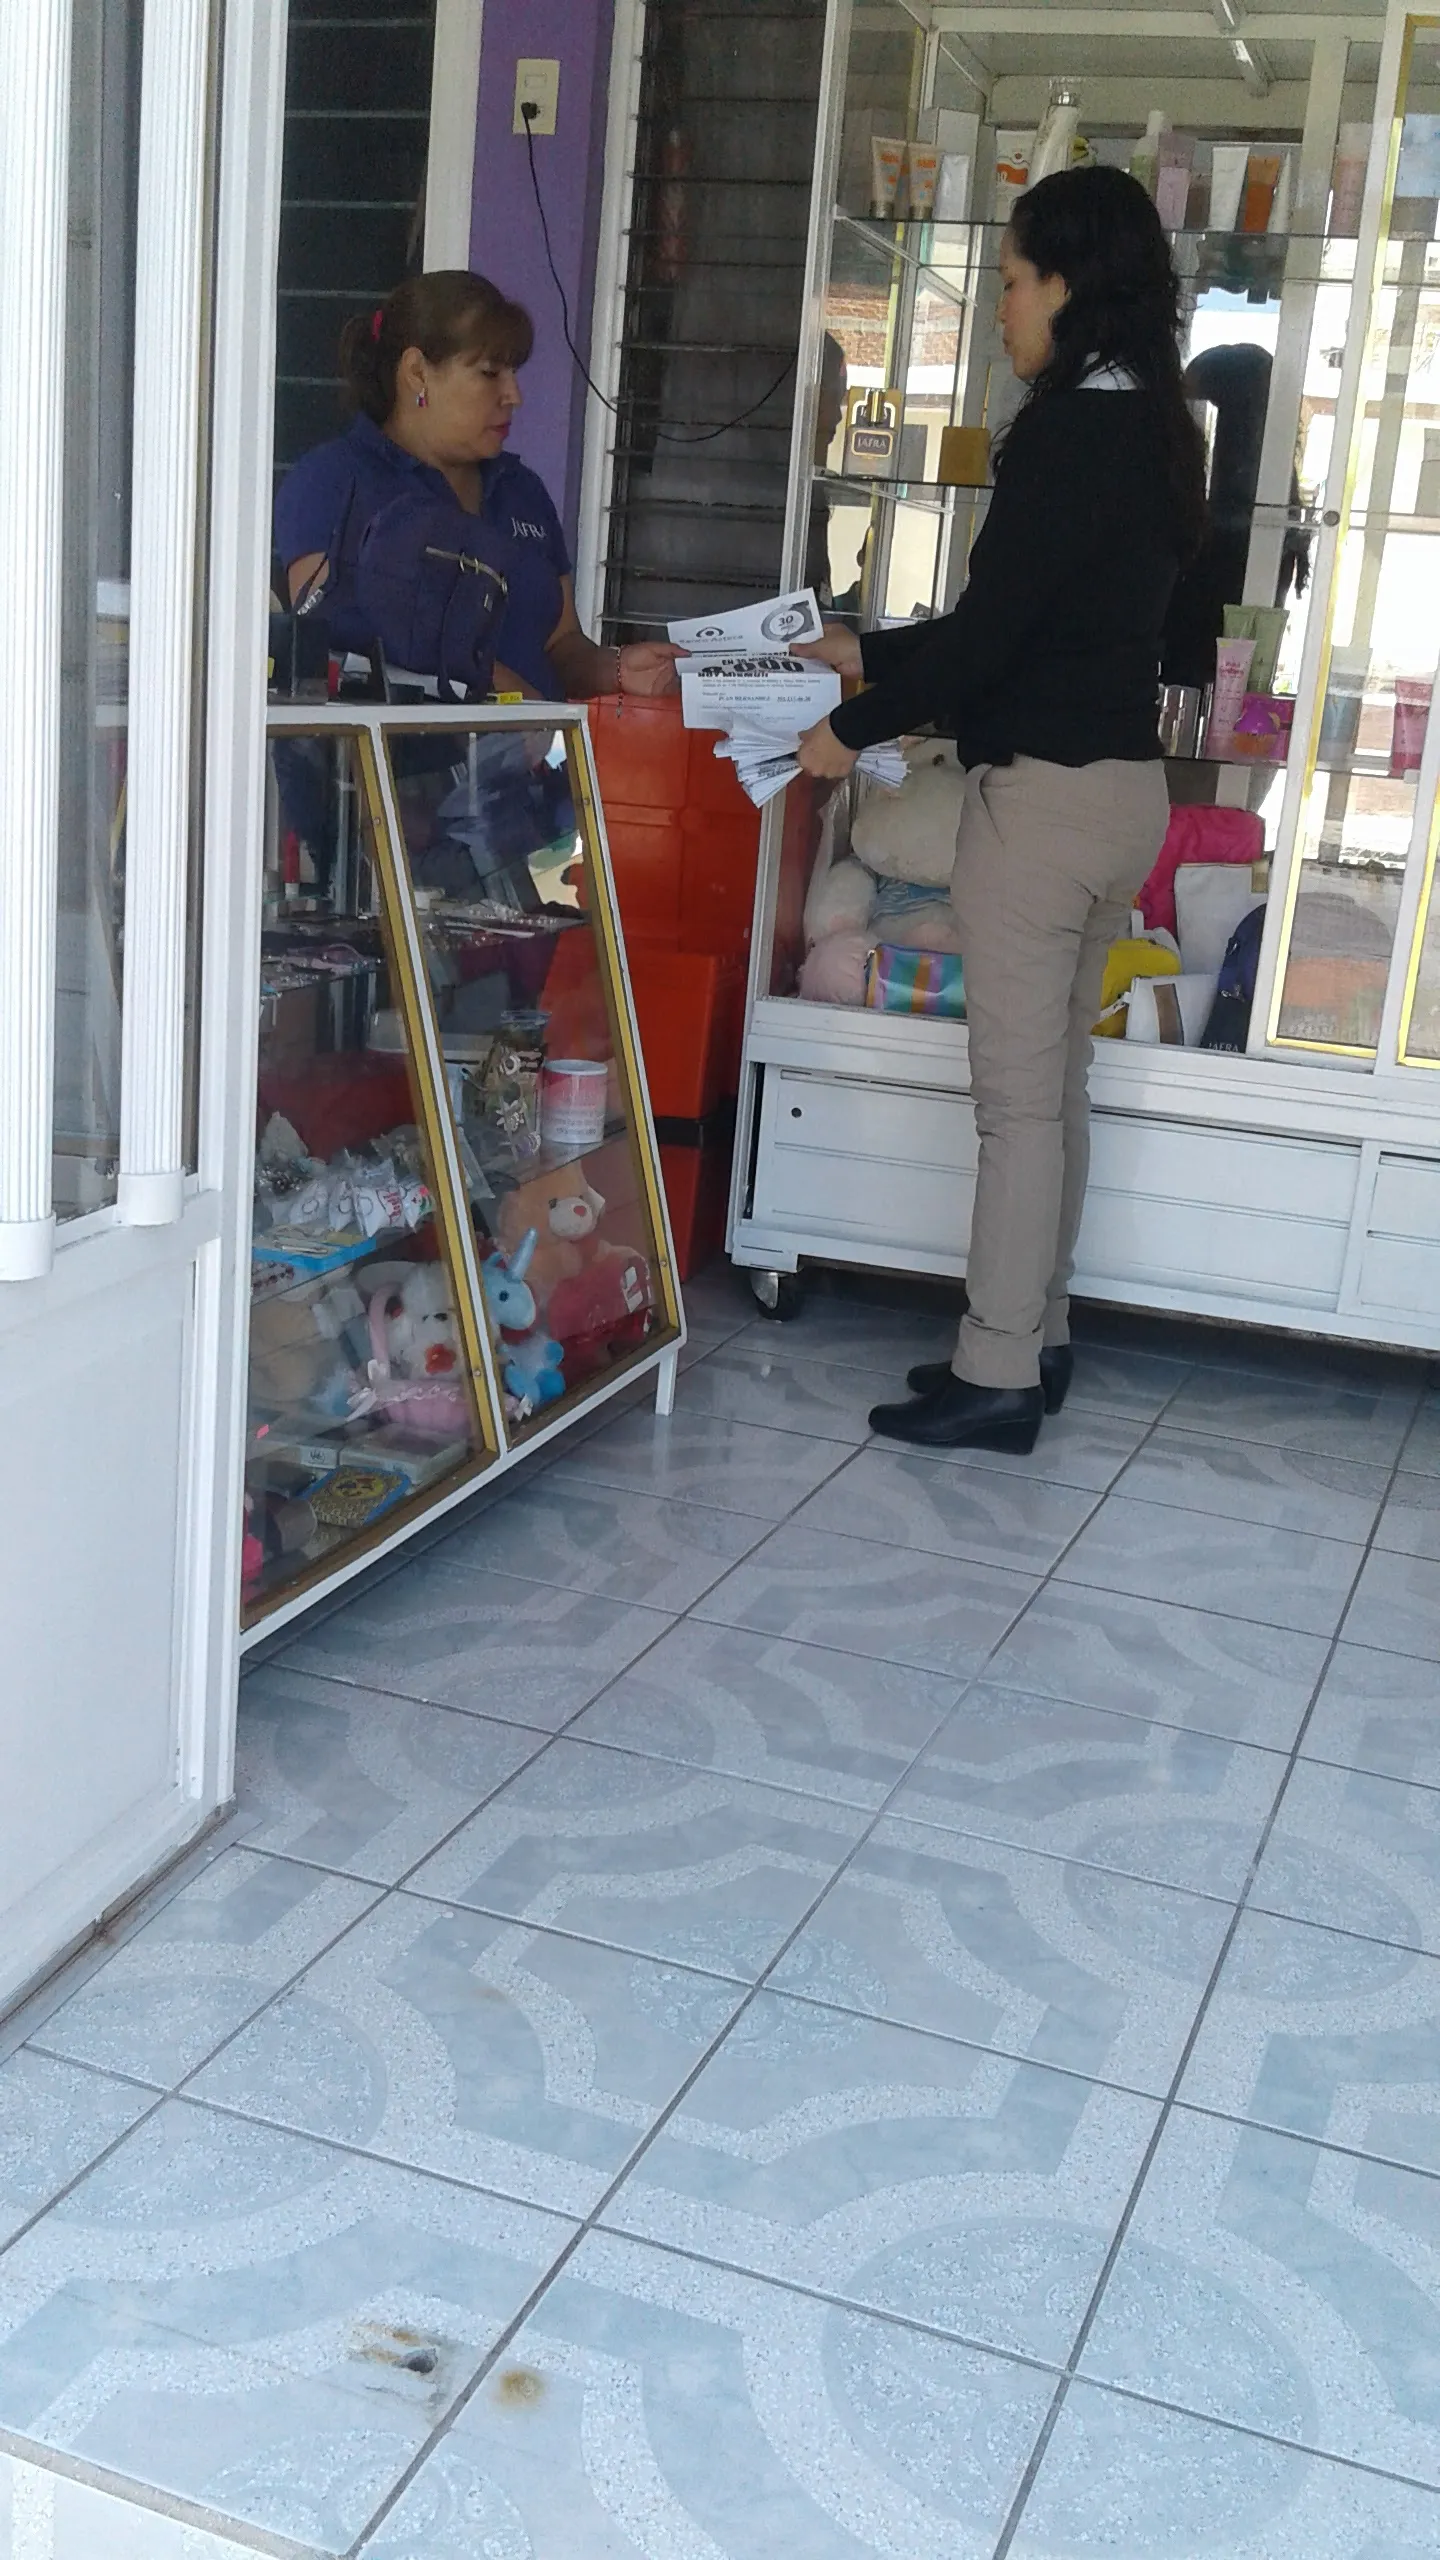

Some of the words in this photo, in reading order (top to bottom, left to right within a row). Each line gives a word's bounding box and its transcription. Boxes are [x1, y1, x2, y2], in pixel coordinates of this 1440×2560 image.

[857, 437, 887, 449] JAFRA
[510, 517, 547, 539] JAFRA
[778, 615, 794, 626] 30
